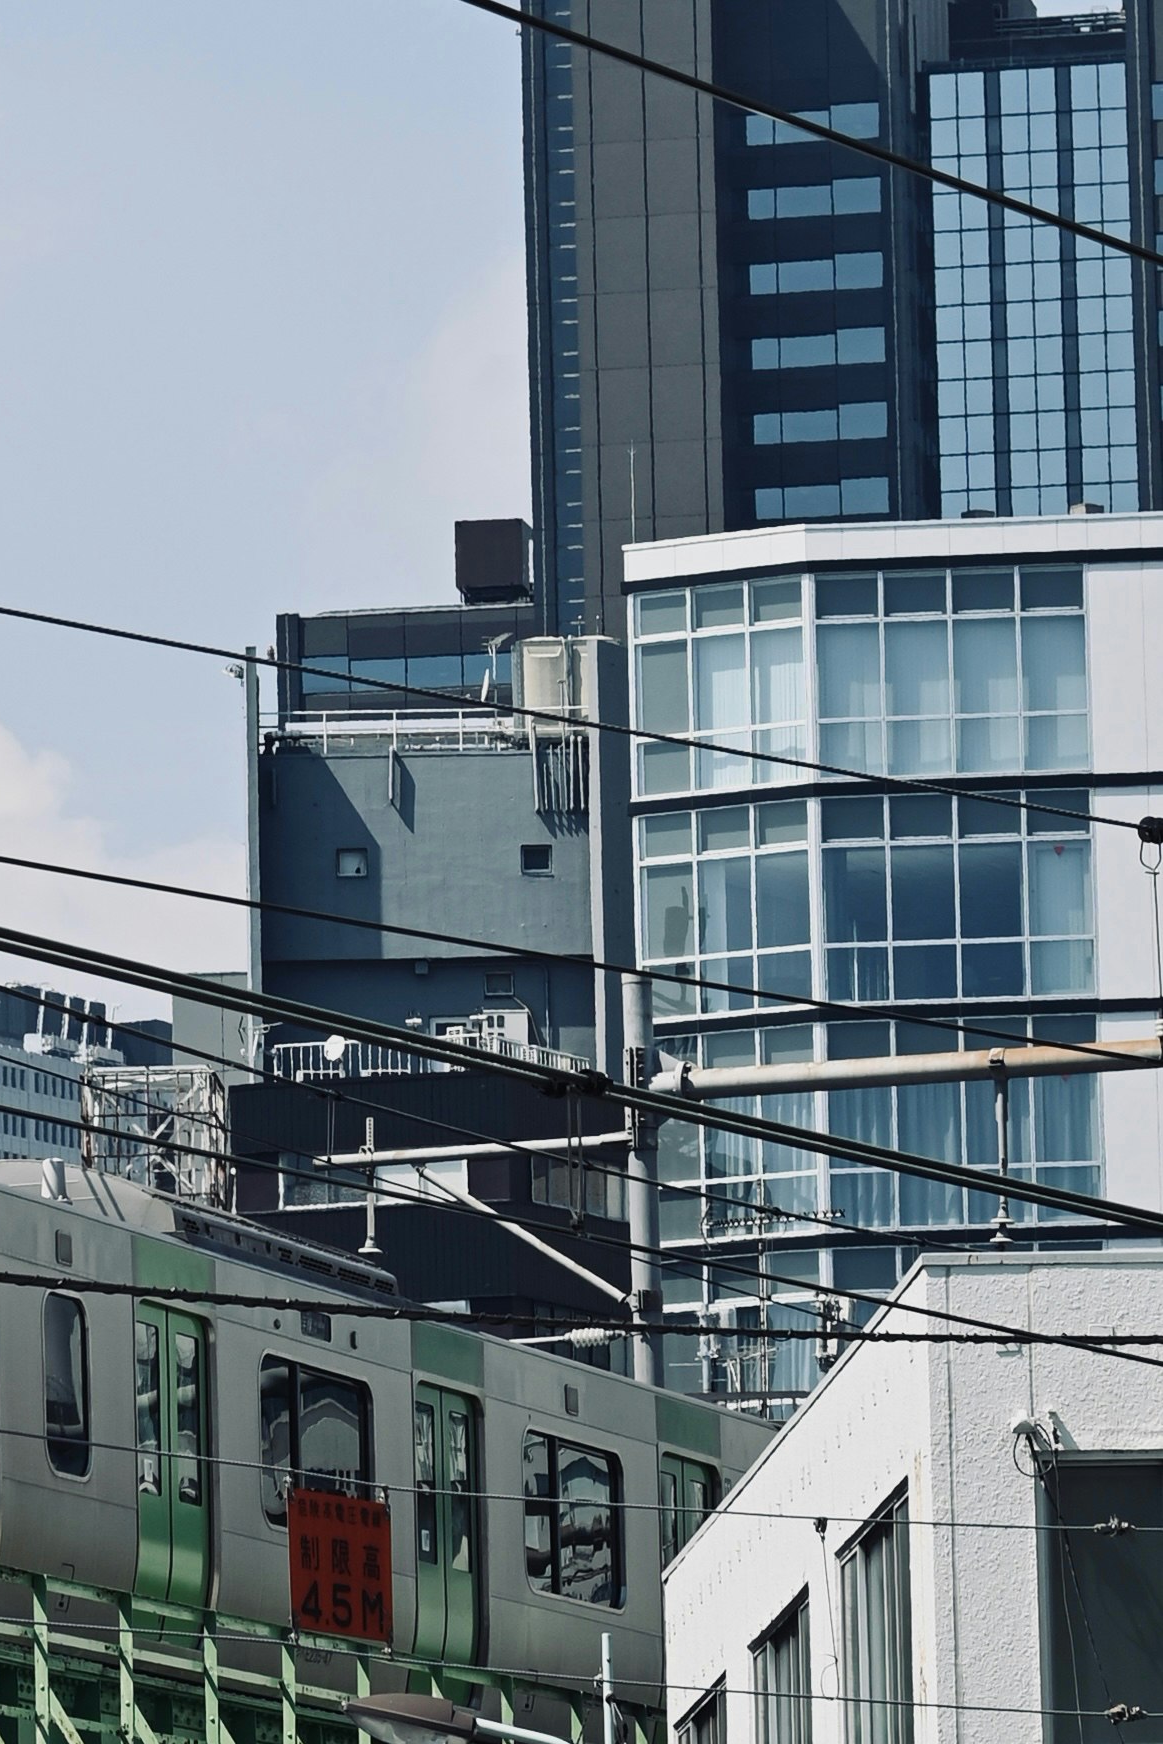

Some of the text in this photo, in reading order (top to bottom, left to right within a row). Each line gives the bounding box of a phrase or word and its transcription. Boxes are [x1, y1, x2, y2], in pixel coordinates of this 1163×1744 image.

[299, 1534, 382, 1581] 制限高
[301, 1580, 384, 1634] 4.5M
